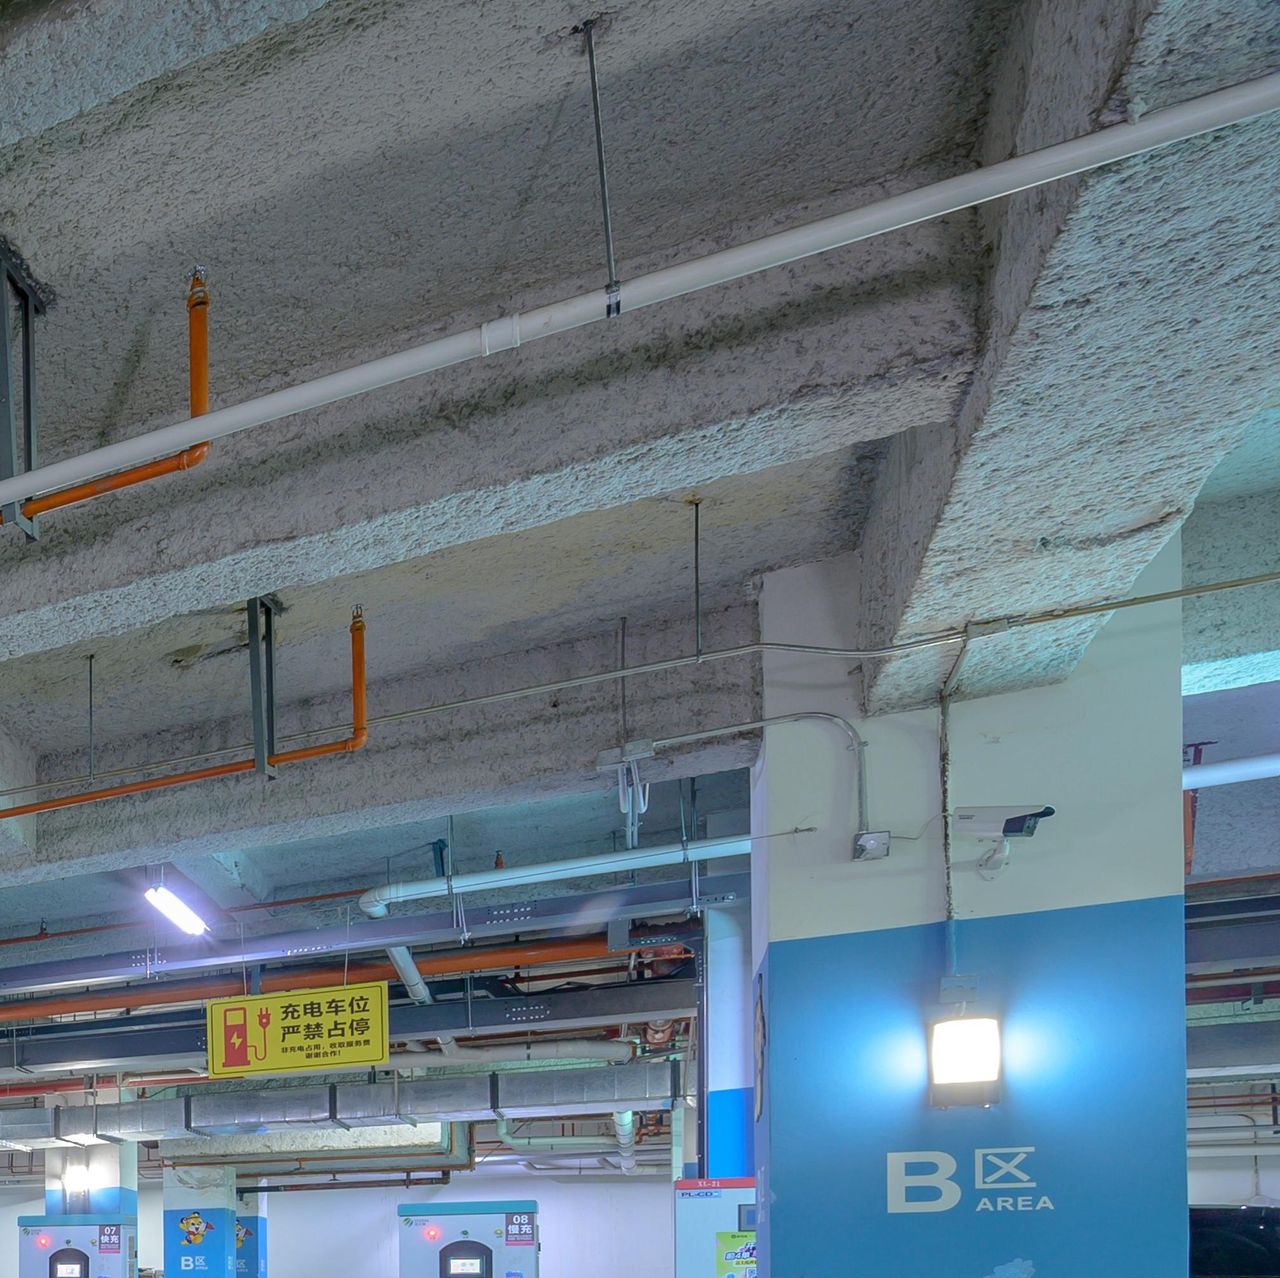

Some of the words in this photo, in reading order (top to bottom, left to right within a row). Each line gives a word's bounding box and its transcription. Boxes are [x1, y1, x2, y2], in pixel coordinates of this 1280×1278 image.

[280, 996, 370, 1021] 充电车位
[281, 1018, 370, 1042] 严禁占停
[975, 1196, 1055, 1212] AREA
[512, 1215, 529, 1224] 08
[104, 1227, 116, 1235] 07
[508, 1224, 532, 1234] 慢充
